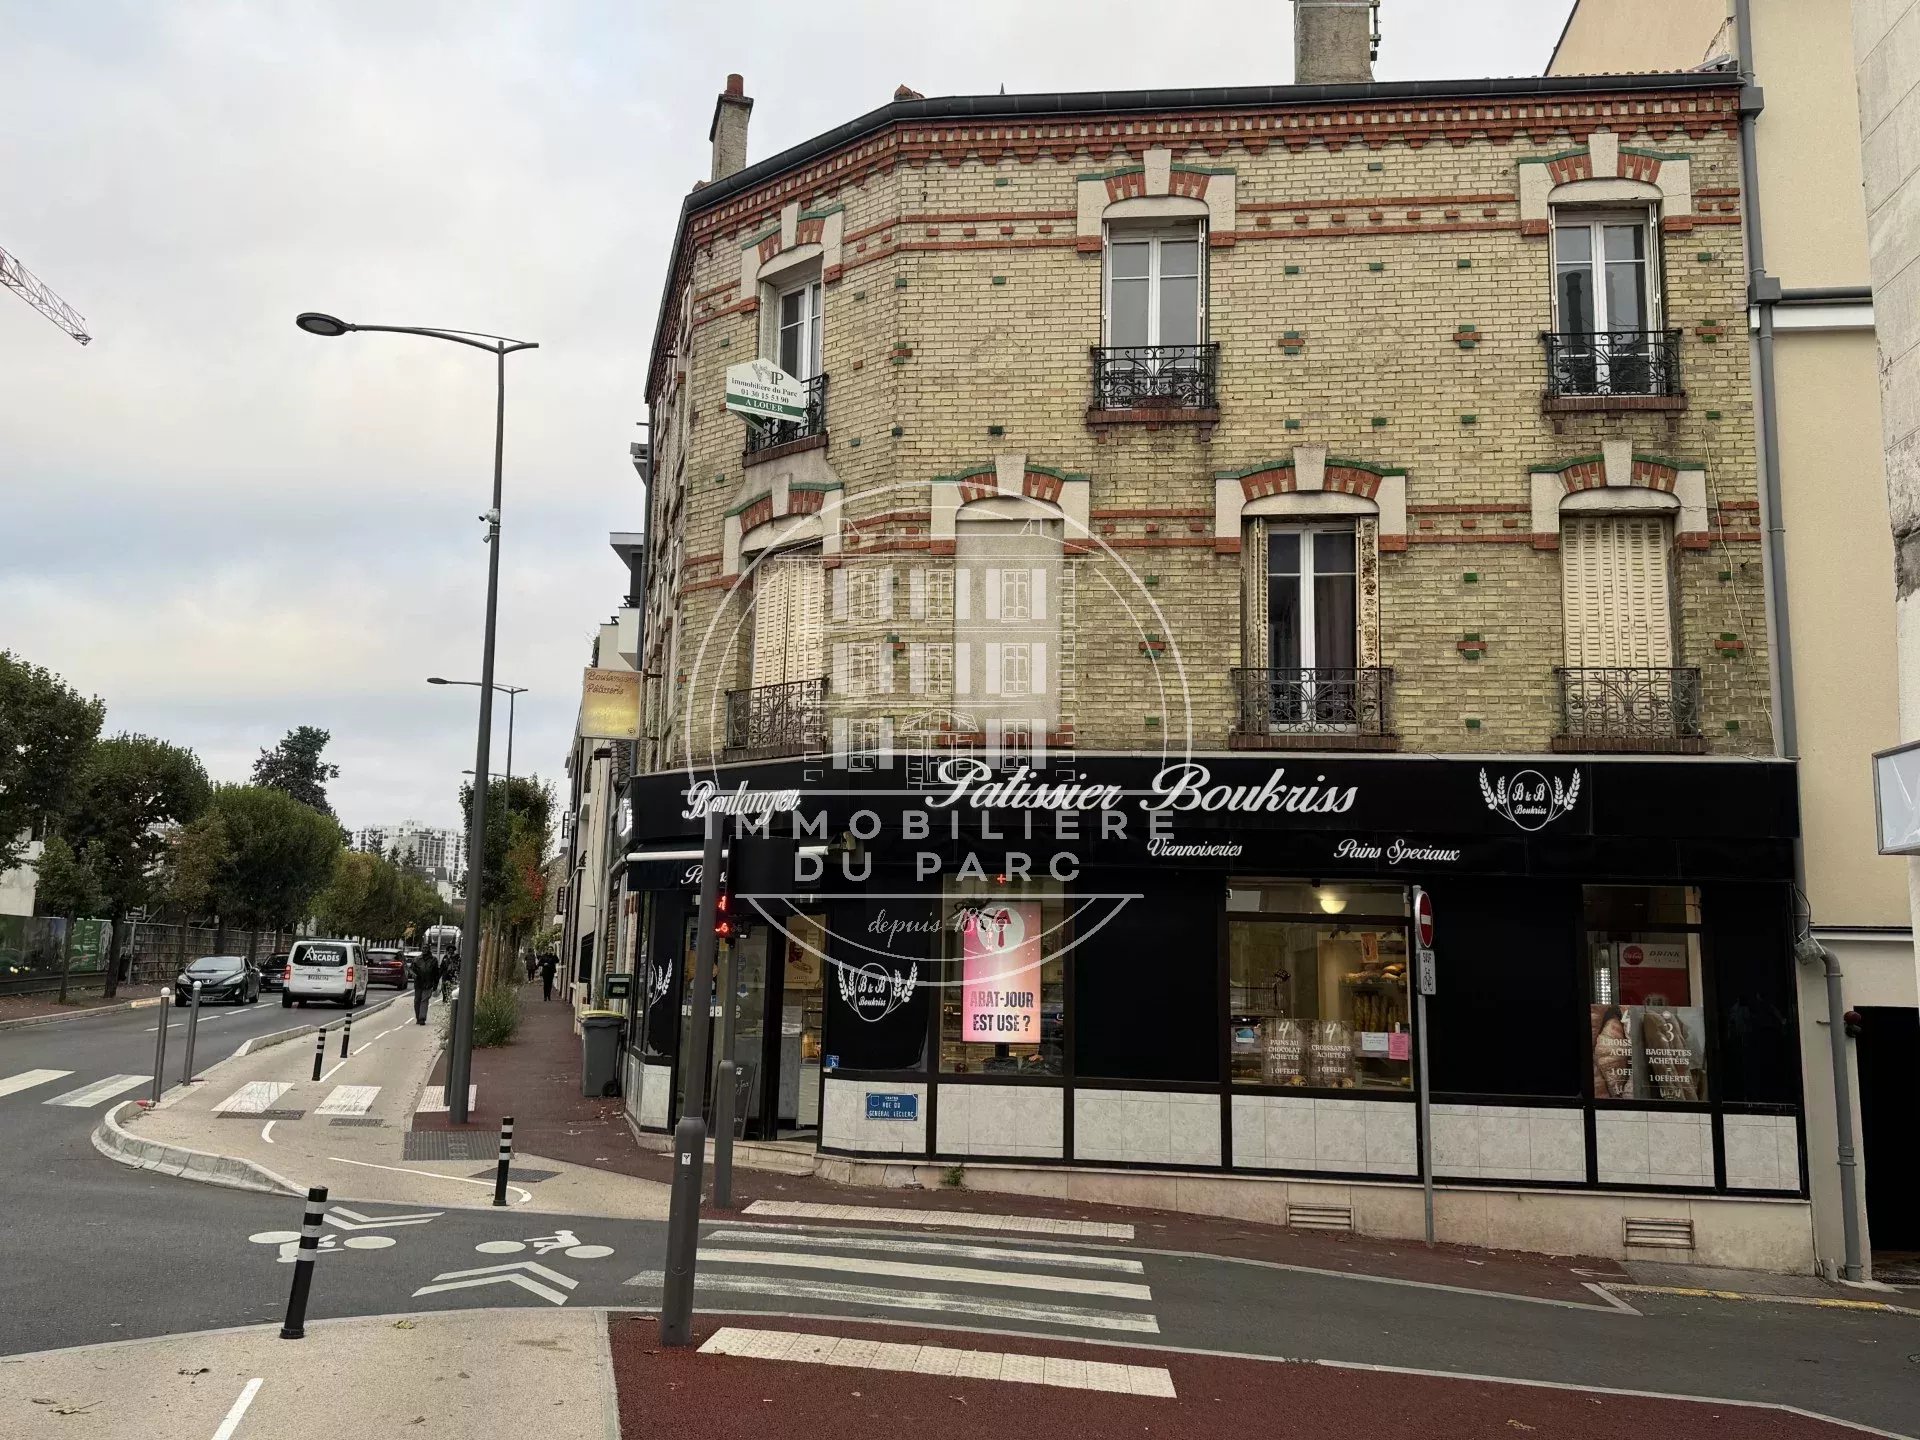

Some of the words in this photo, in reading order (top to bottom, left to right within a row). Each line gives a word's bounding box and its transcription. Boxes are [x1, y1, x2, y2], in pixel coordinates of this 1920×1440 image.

[731, 377, 771, 392] Immobilière
[782, 388, 798, 398] Parc
[754, 400, 783, 412] LOUER
[681, 779, 802, 826] Boulanger
[924, 757, 1124, 811] Patissier
[1139, 763, 1359, 814] Boukriss
[1512, 782, 1525, 801] B
[1533, 782, 1546, 802] B
[1514, 804, 1547, 815] Boukriss
[1147, 837, 1243, 857] Viennoiseries
[1333, 838, 1382, 859] Pains
[1386, 838, 1461, 865] Speciaux
[858, 976, 868, 994] B
[874, 975, 886, 994] B
[858, 997, 886, 1007] Boukriss
[970, 991, 1034, 1008] ABAT-JOUR
[973, 1014, 994, 1032] EST
[1023, 1015, 1031, 1032] ?
[1278, 1022, 1290, 1040] 4
[1662, 1022, 1674, 1042] 3
[1326, 1023, 1337, 1042] 4
[1645, 1048, 1692, 1057] BAGUETTES
[1654, 1074, 1690, 1082] OFFERTE
